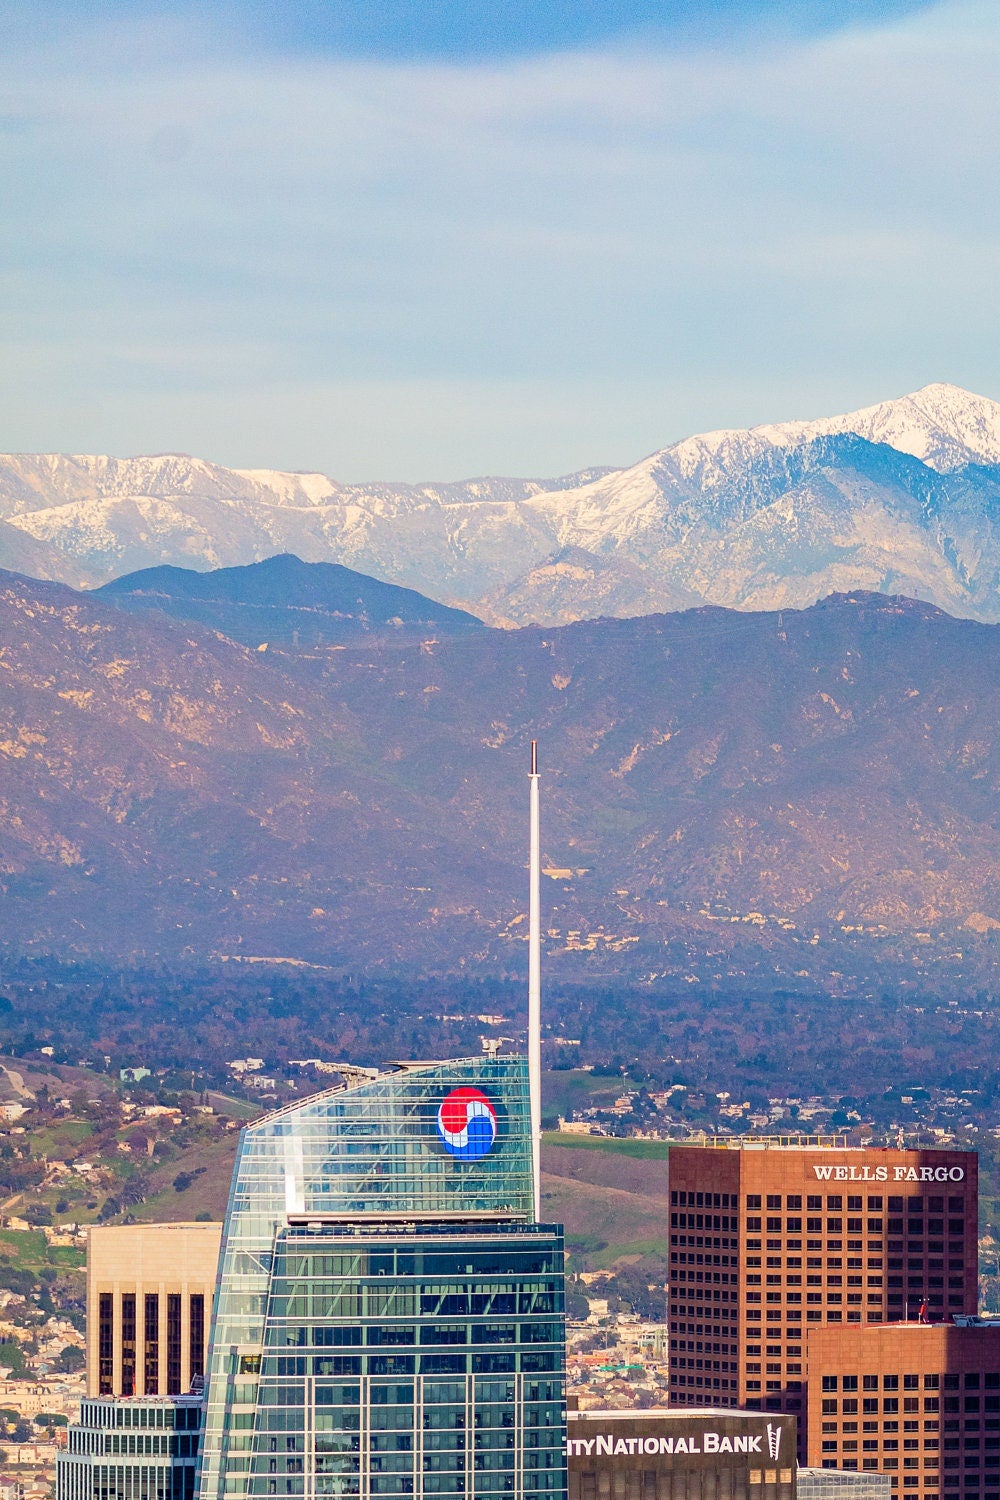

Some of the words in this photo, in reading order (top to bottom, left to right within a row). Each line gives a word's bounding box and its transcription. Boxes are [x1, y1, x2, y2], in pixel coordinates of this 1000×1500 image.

[813, 1165, 888, 1181] WELLS
[893, 1166, 965, 1182] FARGO
[703, 1432, 763, 1454] BANK
